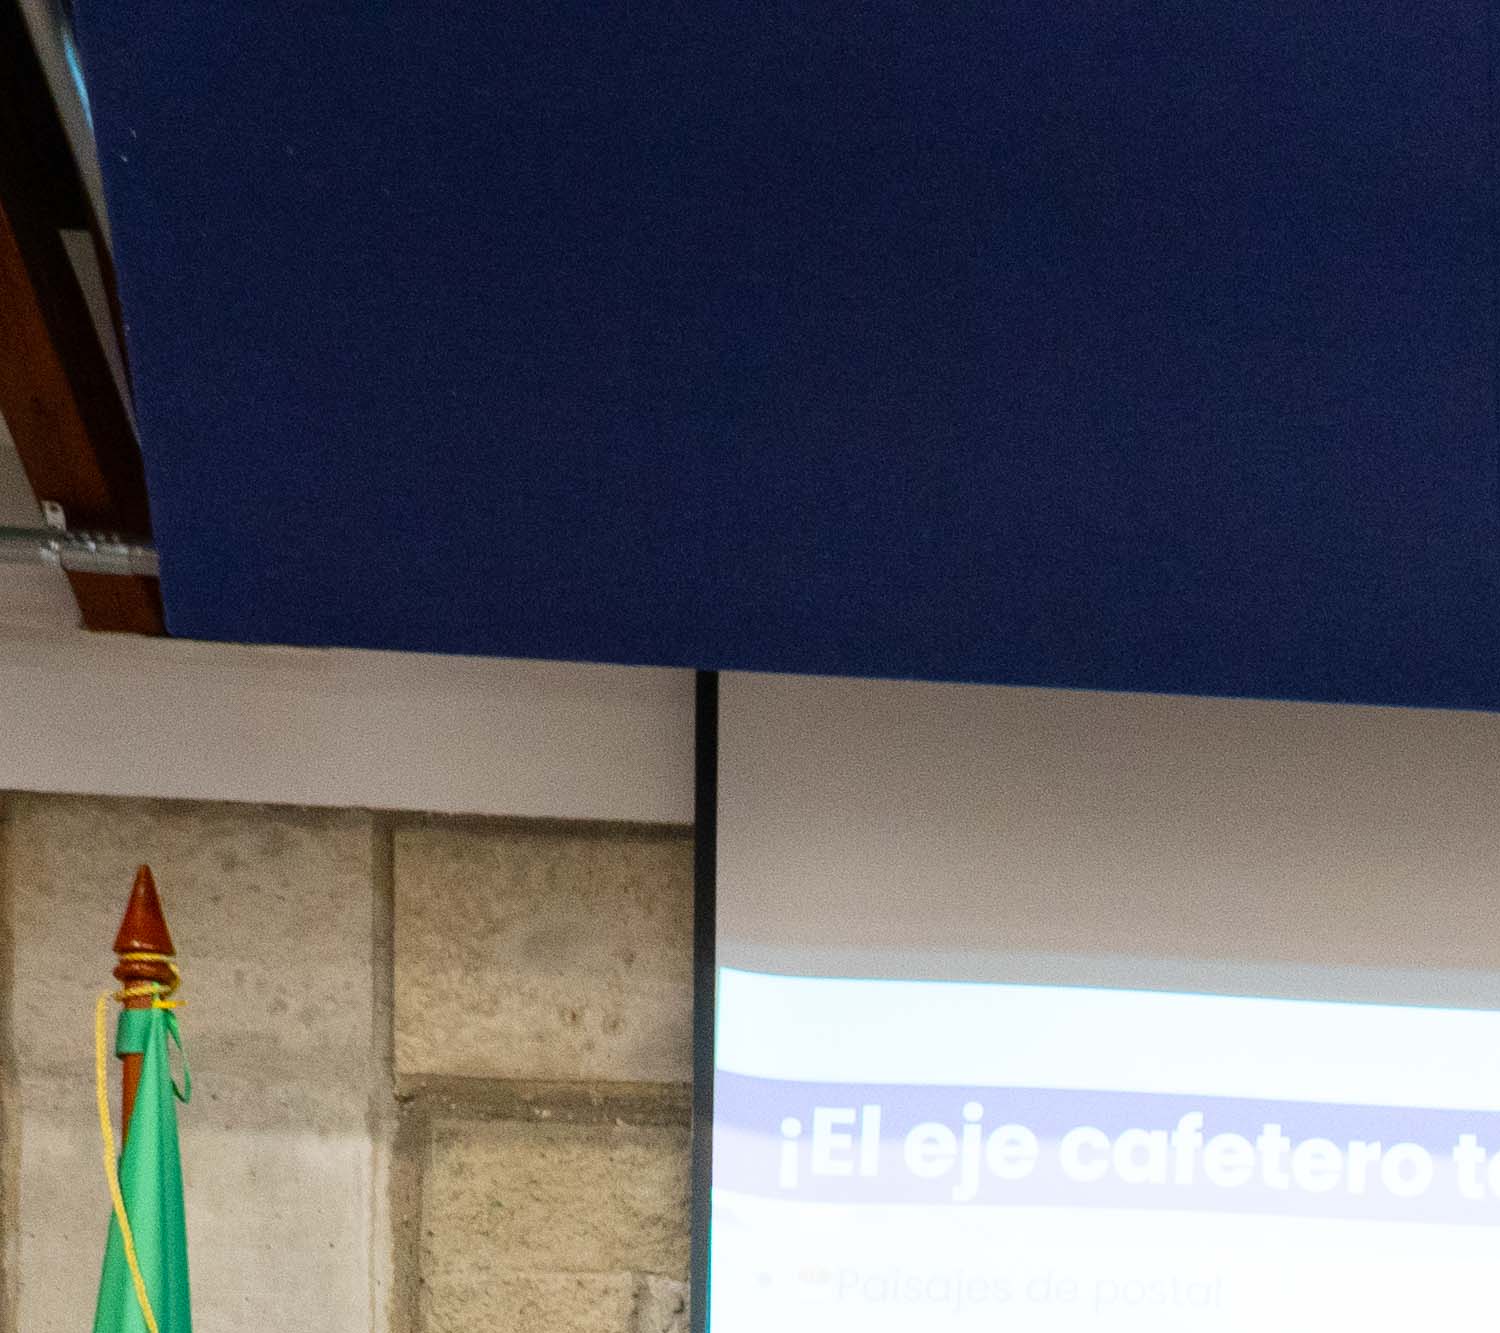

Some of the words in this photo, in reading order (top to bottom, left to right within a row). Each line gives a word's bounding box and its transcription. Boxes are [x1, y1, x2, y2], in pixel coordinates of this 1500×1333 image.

[779, 1106, 881, 1190] ¡El
[906, 1104, 1038, 1202] eje
[1060, 1113, 1433, 1197] cafetero
[834, 1267, 1011, 1317] Paisajes
[1026, 1269, 1079, 1304] de
[1093, 1274, 1223, 1315] postal
